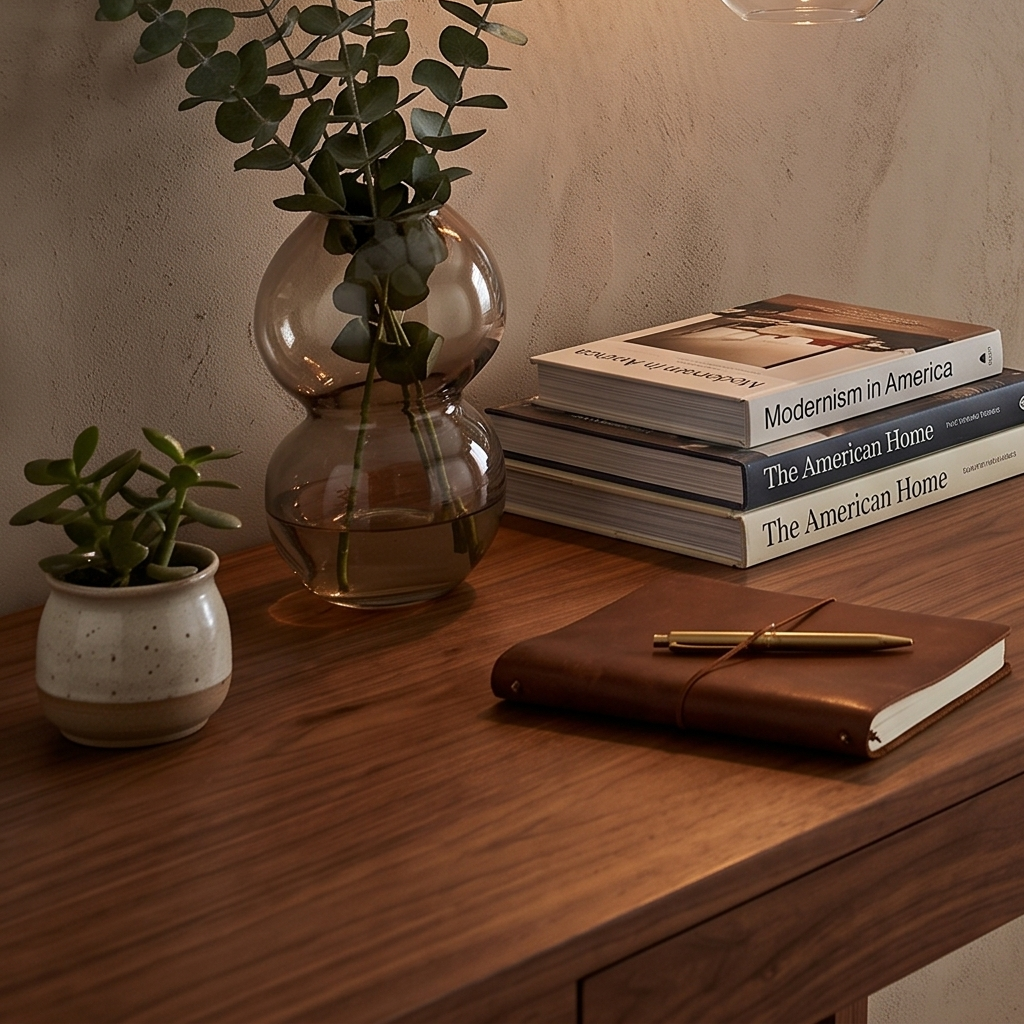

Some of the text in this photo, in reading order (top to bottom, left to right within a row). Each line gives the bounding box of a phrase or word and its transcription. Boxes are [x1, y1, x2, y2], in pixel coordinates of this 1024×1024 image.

[764, 361, 953, 430] Modernism in America
[763, 425, 934, 490] The American Home
[762, 471, 948, 548] The American Home
